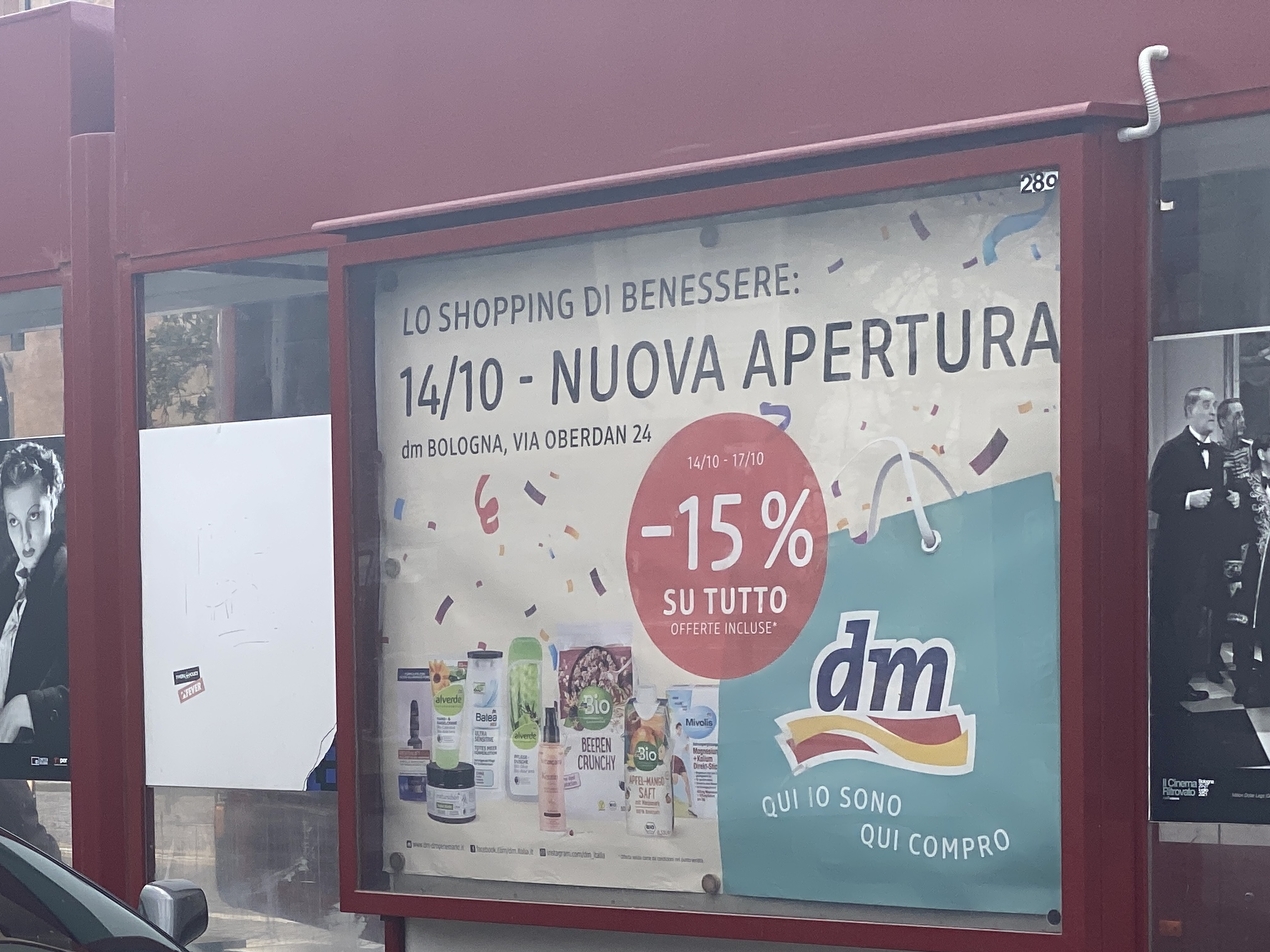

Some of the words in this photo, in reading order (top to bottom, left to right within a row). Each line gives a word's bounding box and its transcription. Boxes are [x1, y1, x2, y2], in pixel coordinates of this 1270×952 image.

[403, 301, 431, 337] LO
[439, 288, 574, 332] SHOPPING
[584, 281, 611, 315] DI
[622, 262, 800, 312] BENESSERE:
[399, 354, 504, 421] 14/10
[551, 334, 725, 405] NUOVA
[742, 301, 1060, 390] APERTURA
[401, 439, 422, 459] dm
[427, 432, 509, 460] BOLOGNA,
[513, 429, 540, 452] VIA
[545, 425, 627, 449] OBERDAN
[633, 422, 652, 444] 24
[687, 455, 719, 470] 14/10
[732, 452, 764, 467] 17/10
[641, 493, 743, 571] -15
[761, 488, 814, 569] %
[663, 588, 694, 615] SU
[704, 585, 787, 614] TUTTO
[671, 622, 720, 635] OFFERTE
[816, 619, 948, 713] dm
[435, 695, 461, 704] alverde
[583, 694, 610, 715] Bio
[476, 712, 498, 722] Balea
[686, 718, 713, 727] Mivolis
[581, 737, 612, 753] BEEREN
[637, 746, 657, 761] Bio
[577, 755, 616, 771] CRUNCHY
[1163, 787, 1195, 796] Ritrovato
[1168, 779, 1197, 788] Cinema
[639, 787, 656, 799] SAFT
[761, 787, 799, 818] QUI
[809, 786, 830, 808] IO
[839, 786, 903, 817] SONO
[859, 822, 899, 851] QUI
[909, 828, 1010, 861] COMPRO
